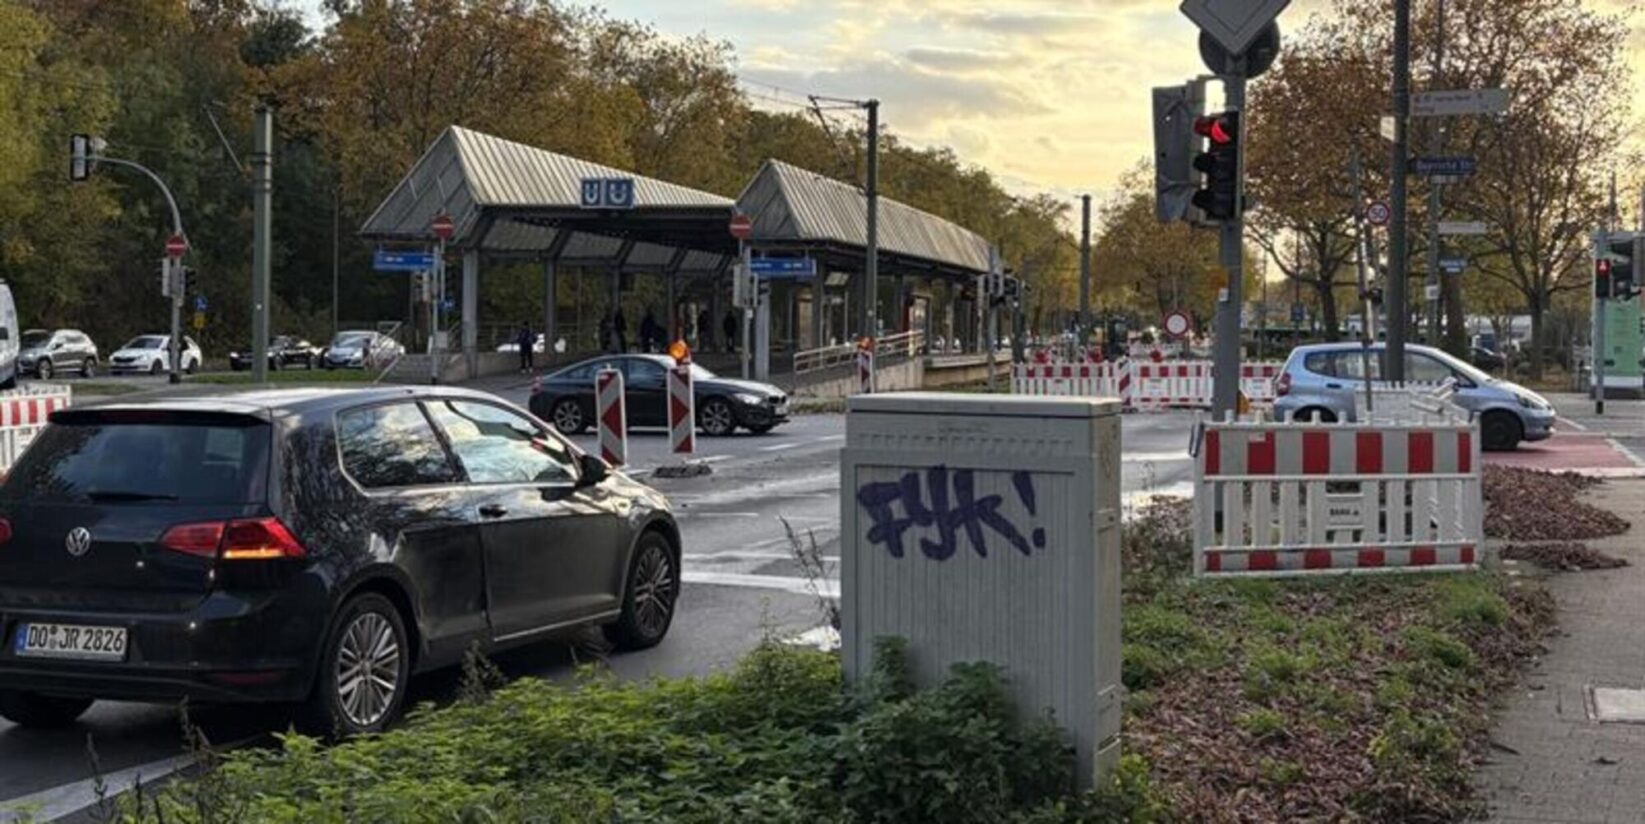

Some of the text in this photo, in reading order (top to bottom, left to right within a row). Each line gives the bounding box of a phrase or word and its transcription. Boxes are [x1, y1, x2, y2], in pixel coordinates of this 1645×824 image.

[585, 183, 598, 203] U
[610, 183, 627, 204] U
[1370, 206, 1386, 220] 50
[28, 626, 124, 652] DO JR 2826
